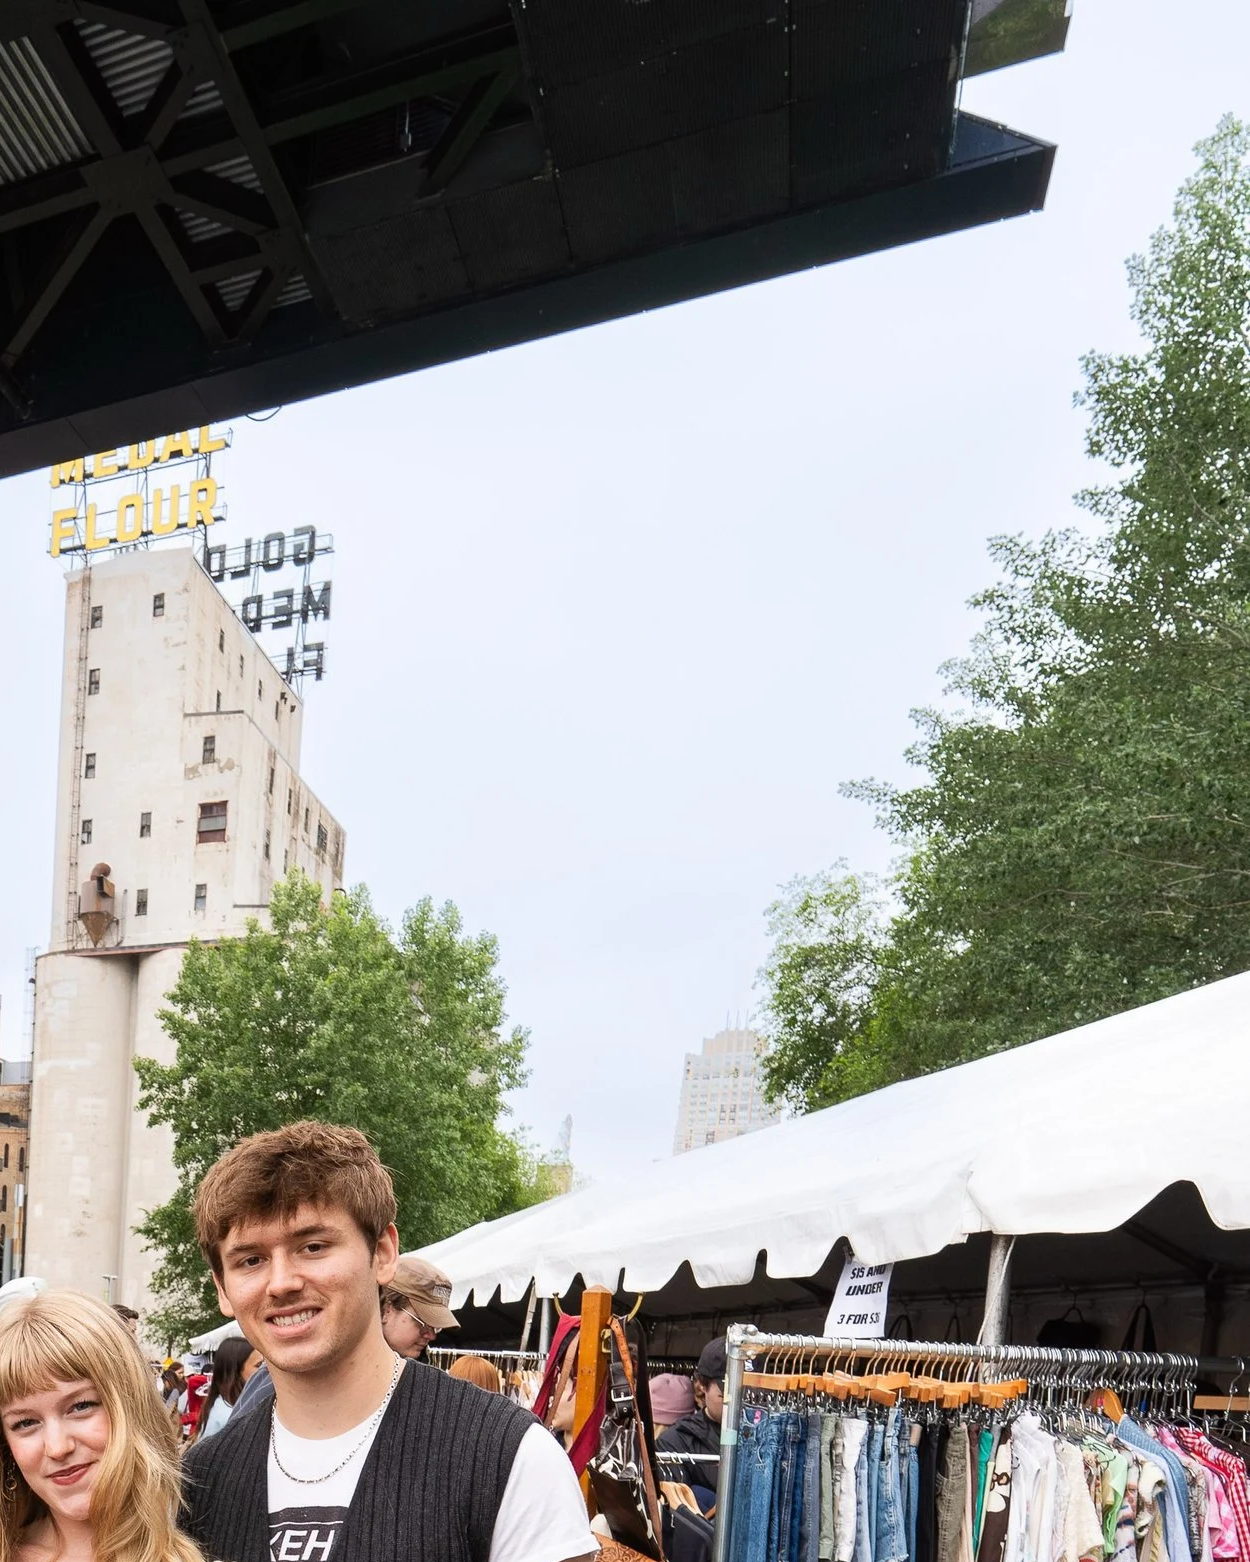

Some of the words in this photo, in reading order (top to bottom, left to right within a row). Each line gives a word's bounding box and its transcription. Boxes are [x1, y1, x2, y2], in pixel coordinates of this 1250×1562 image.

[50, 477, 217, 558] FLOUR
[850, 1267, 865, 1279] $15
[866, 1264, 887, 1277] AND
[845, 1281, 883, 1296] UNDER
[837, 1314, 845, 1325] 3
[846, 1313, 868, 1325] FOR
